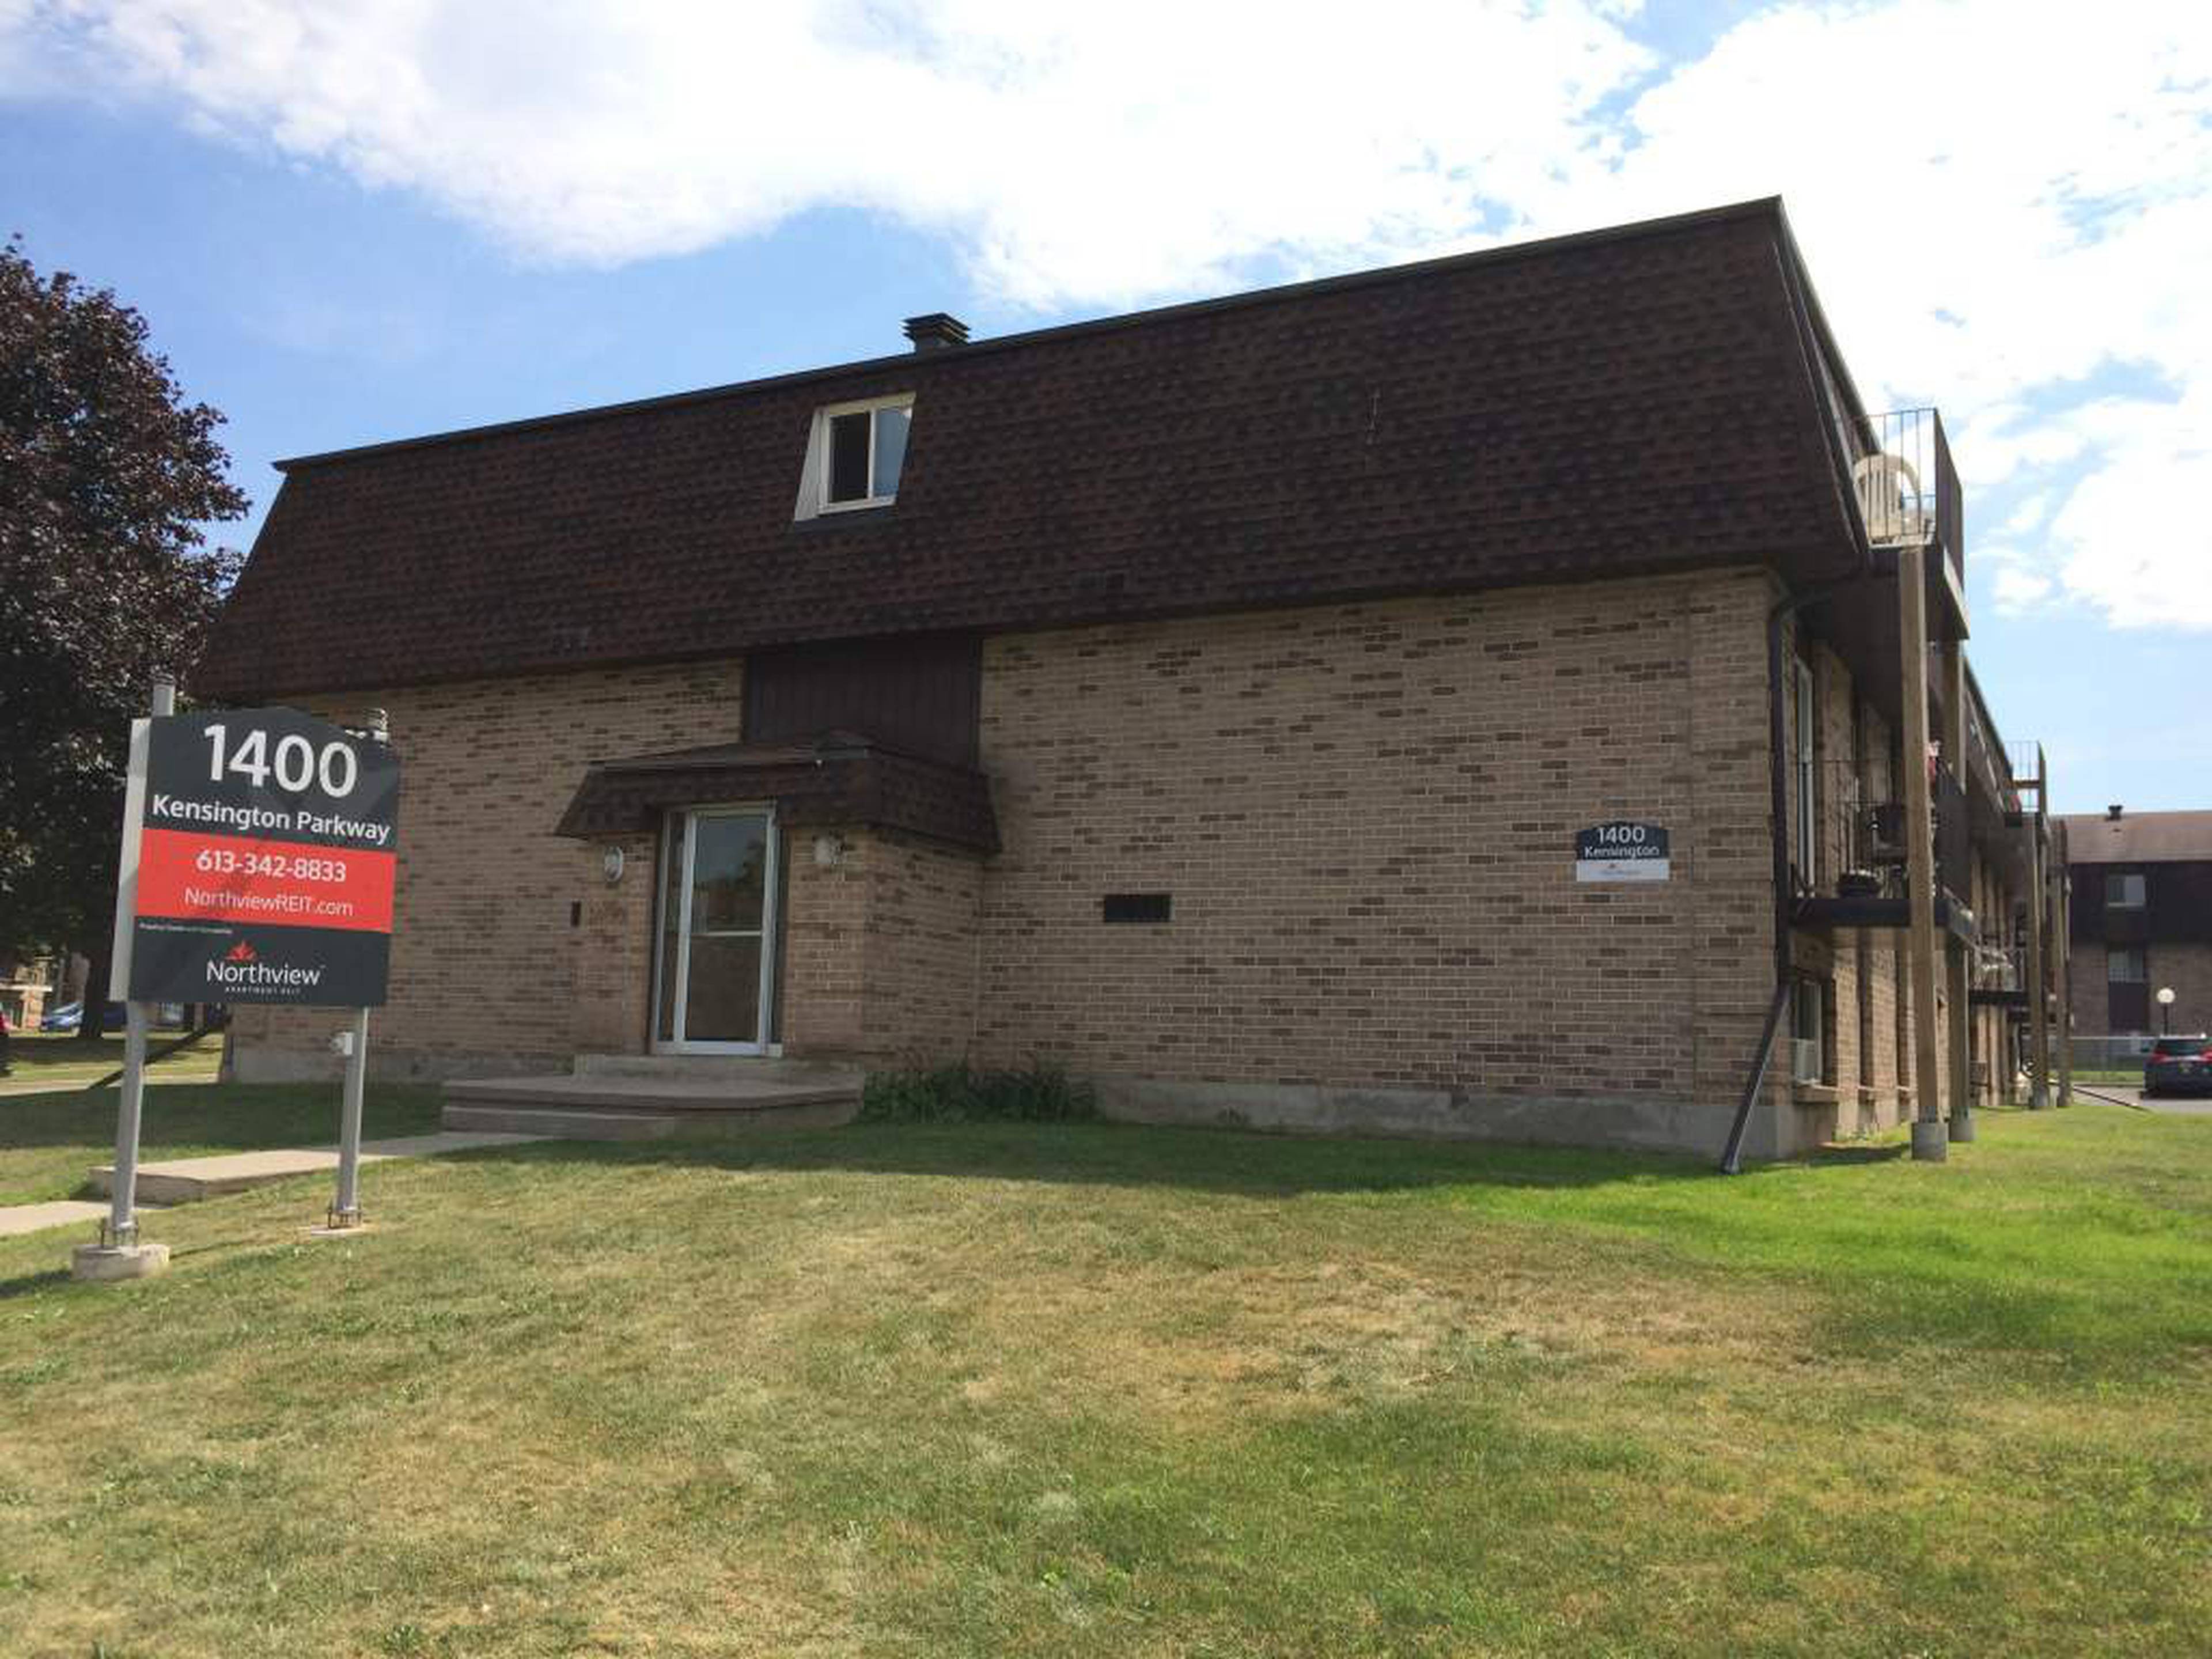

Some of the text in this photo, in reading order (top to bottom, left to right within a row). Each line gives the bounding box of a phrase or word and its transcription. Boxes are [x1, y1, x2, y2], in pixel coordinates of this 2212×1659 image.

[204, 724, 357, 798] 1400
[152, 794, 391, 845] Kensington Parkway
[1597, 826, 1645, 843] 1400
[196, 849, 346, 882] 613-342-8833
[1584, 846, 1660, 859] Kensington
[184, 887, 354, 916] NorthviewREIT.com
[207, 960, 320, 985] Northview
